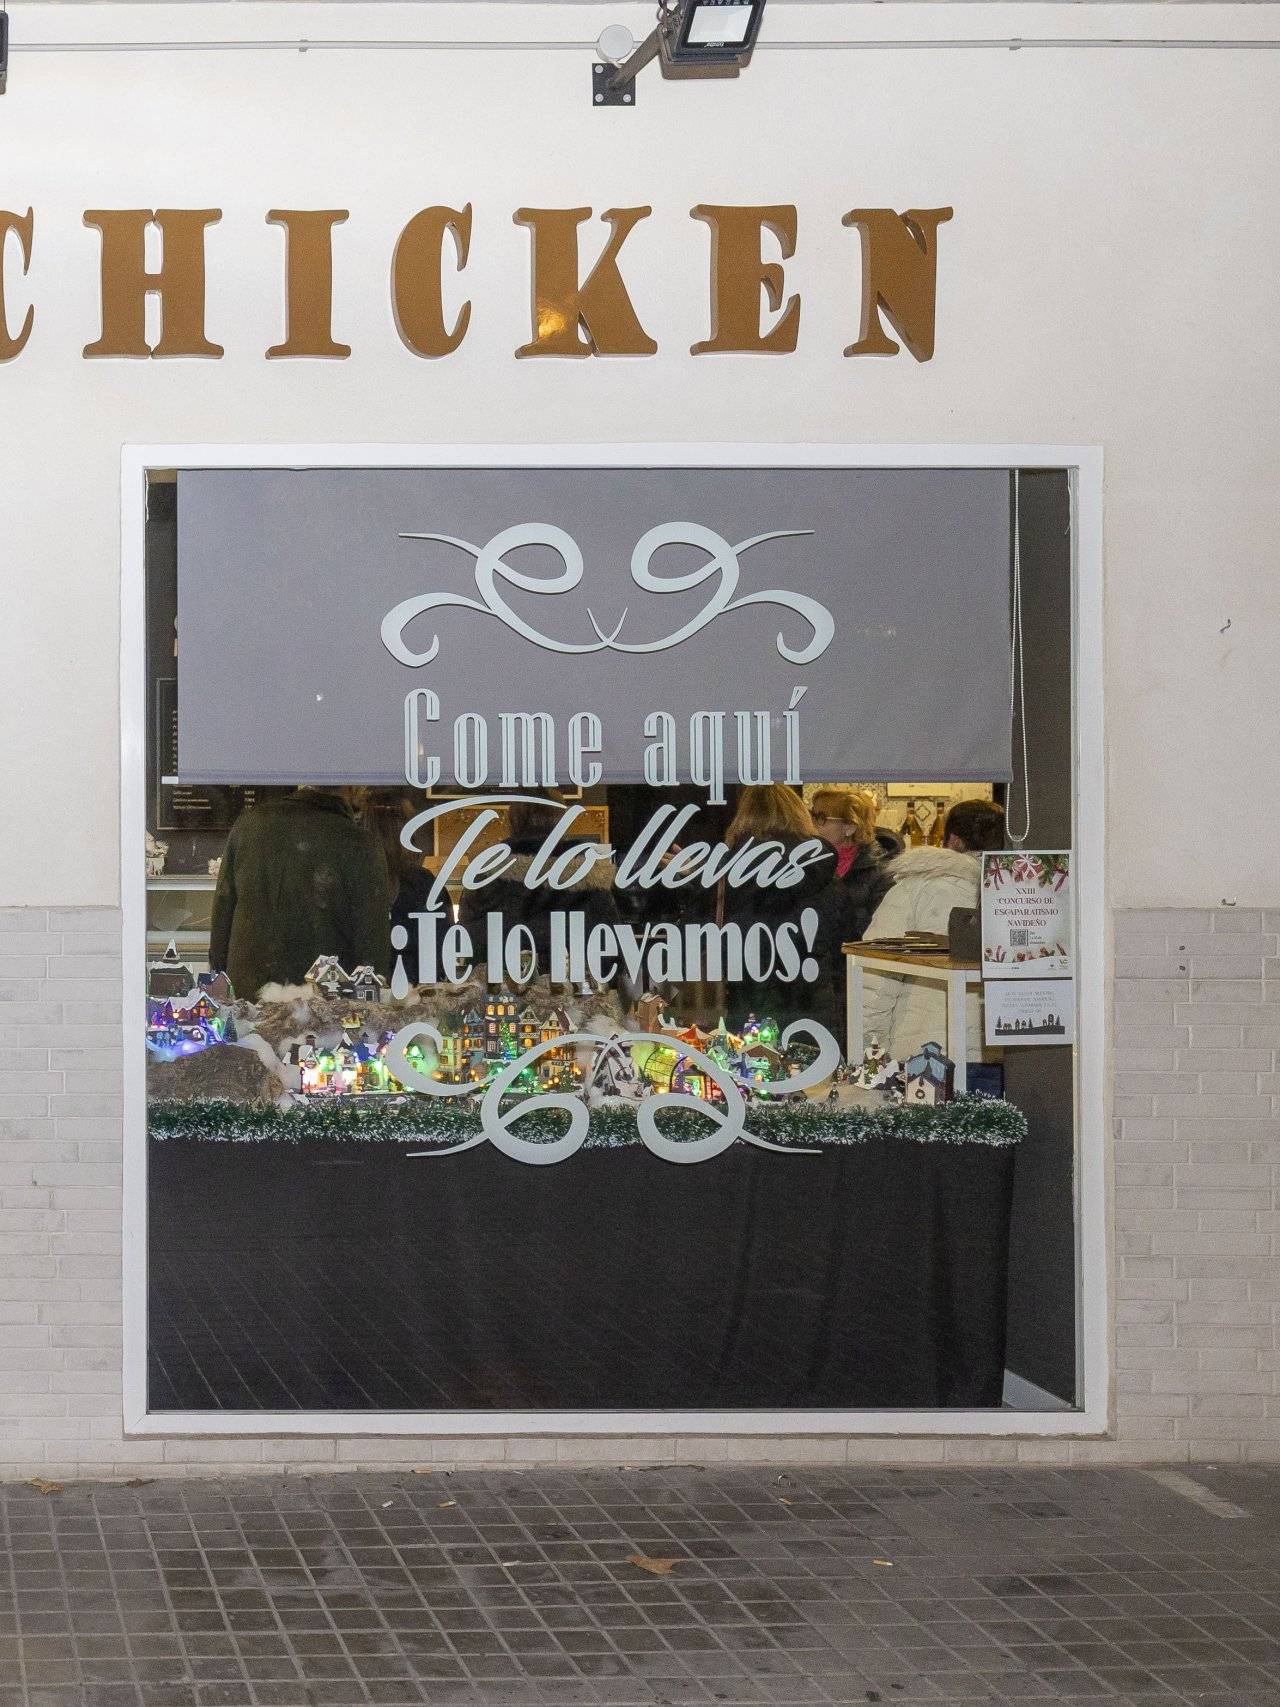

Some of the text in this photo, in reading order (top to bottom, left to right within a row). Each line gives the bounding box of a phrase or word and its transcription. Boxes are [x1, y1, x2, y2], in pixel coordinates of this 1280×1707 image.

[404, 686, 808, 805] Come aquí
[400, 795, 834, 912] Te lo llevas
[390, 907, 820, 1000] ¡Te lo llevamos!
[1007, 918, 1047, 926] NAVIDEÑO
